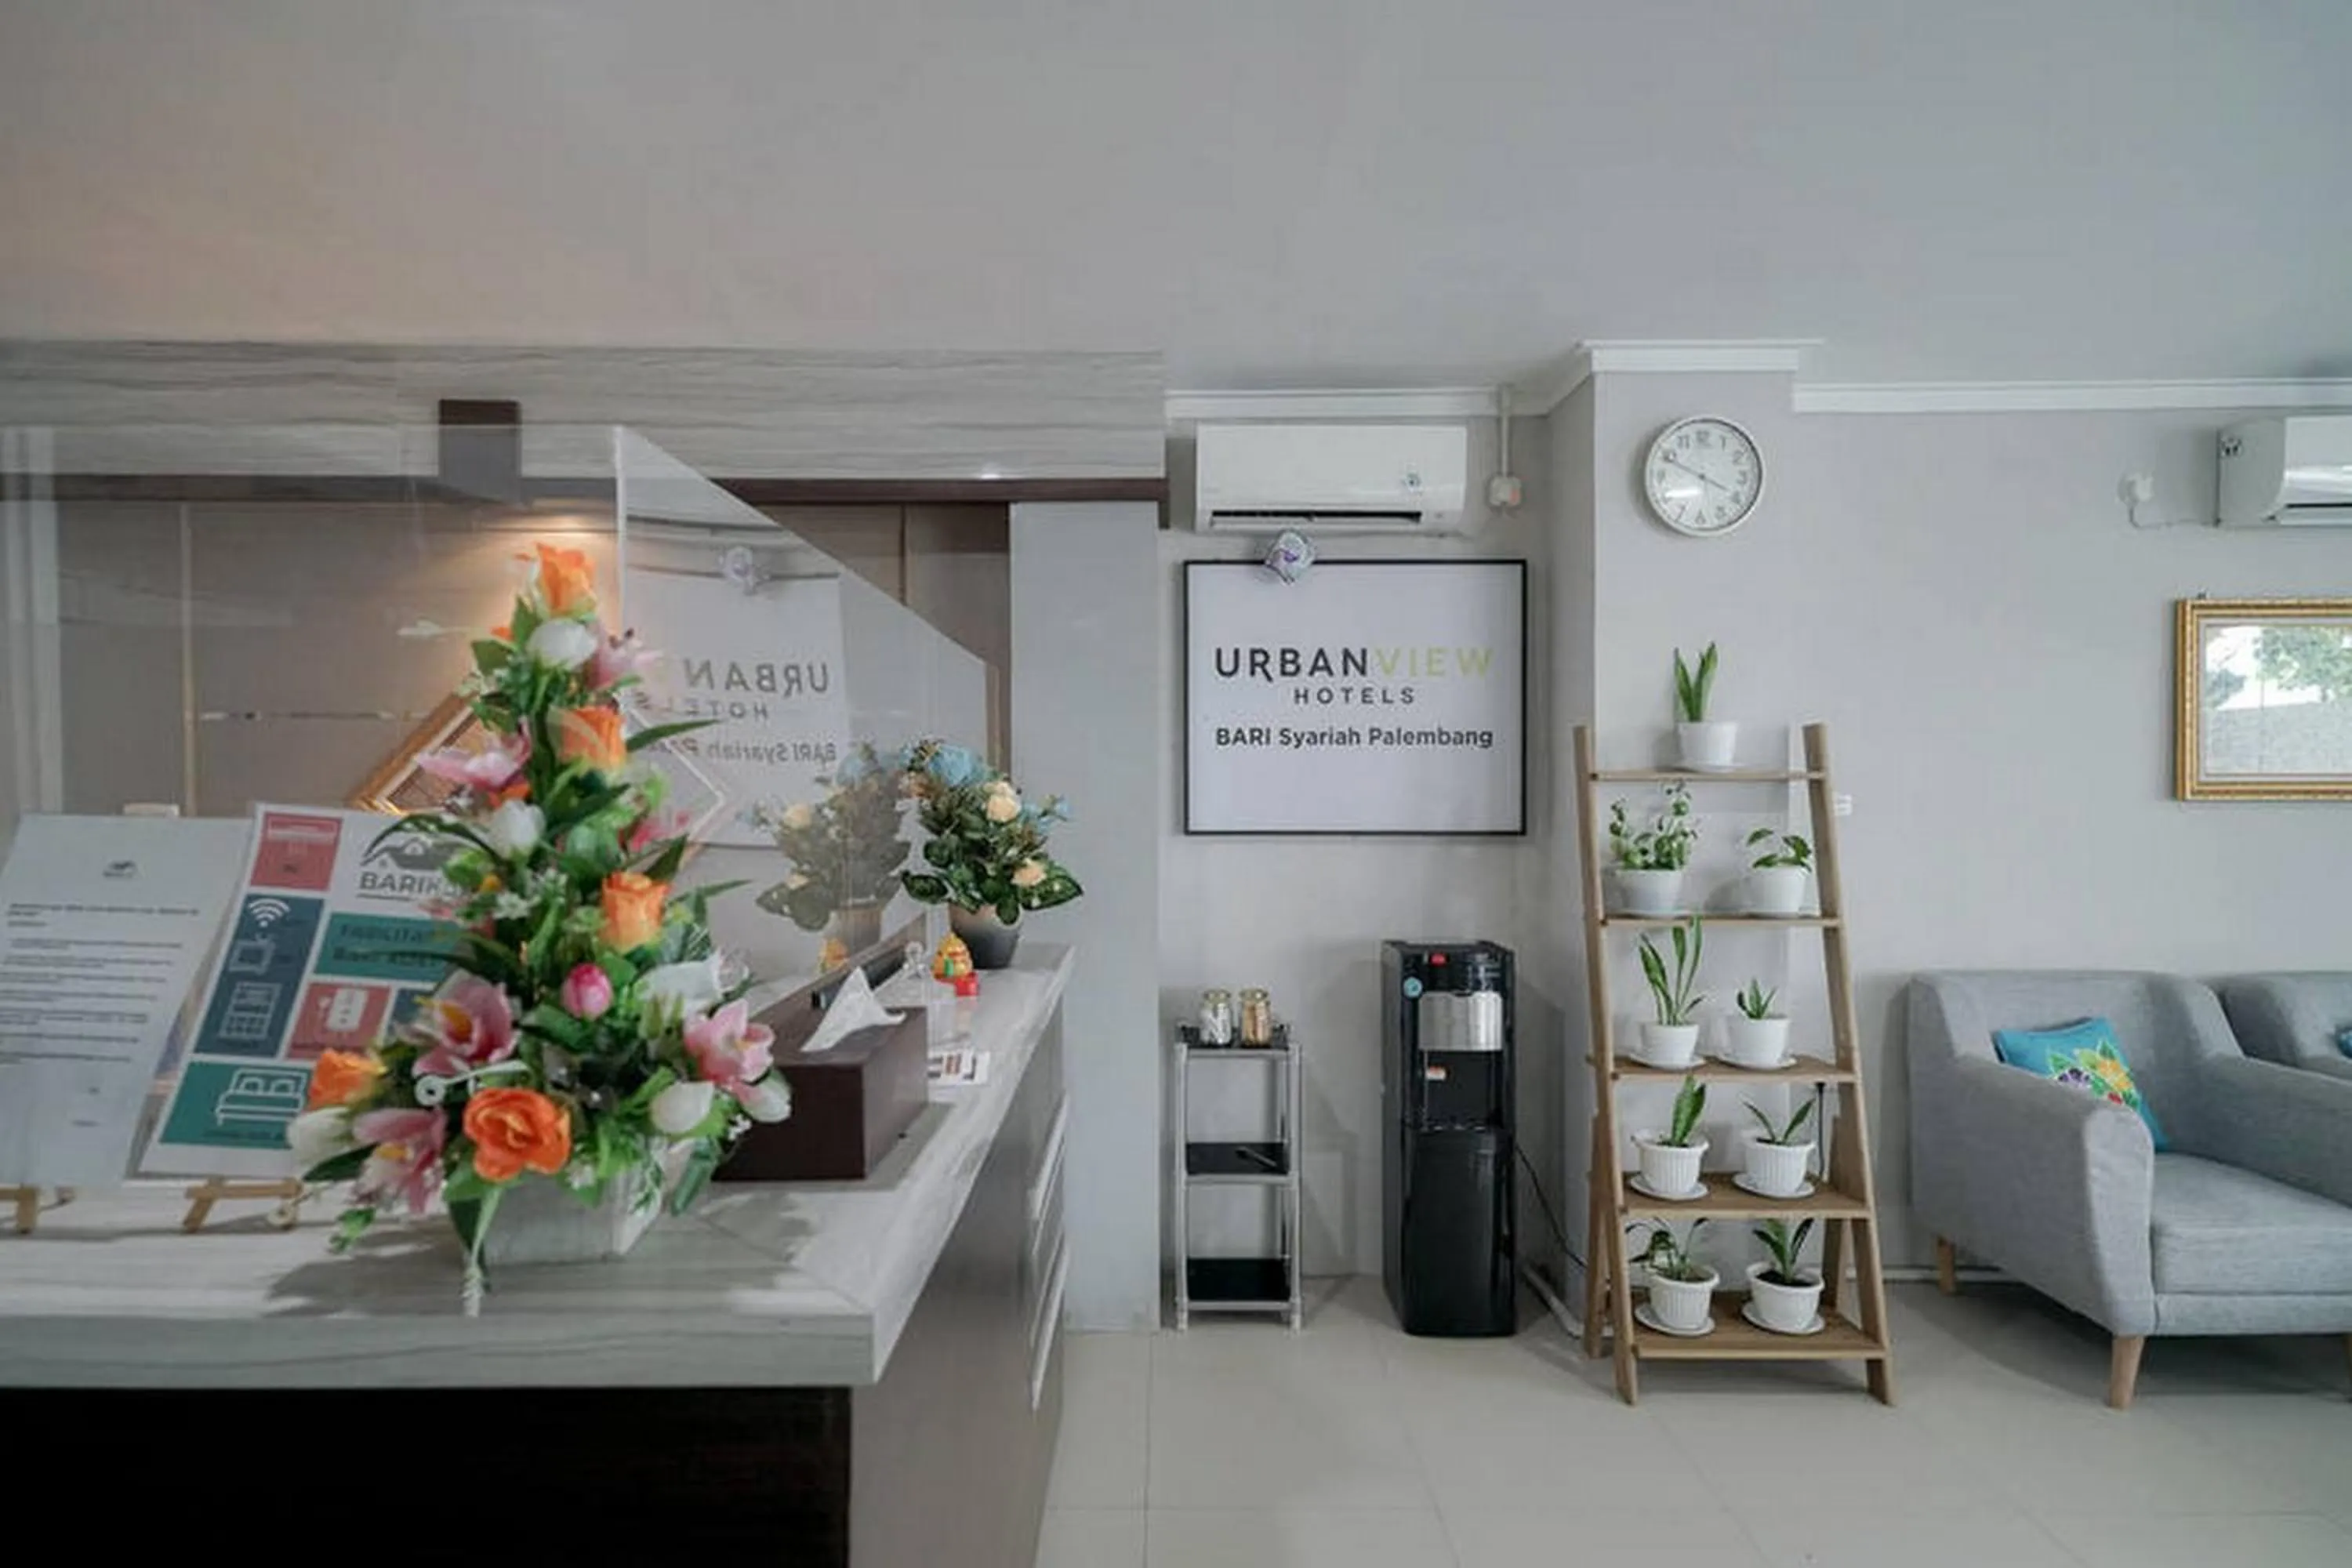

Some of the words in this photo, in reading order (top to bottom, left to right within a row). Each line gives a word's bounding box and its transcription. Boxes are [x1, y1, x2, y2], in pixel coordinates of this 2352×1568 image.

[1676, 434, 1690, 450] 11
[1695, 430, 1712, 449] 12
[1732, 450, 1745, 466] 2
[1737, 470, 1748, 485] 3
[1694, 509, 1707, 525] 6
[1216, 647, 1494, 683] URBANVIEW
[1294, 687, 1414, 705] HOTELS
[1216, 727, 1272, 746] BARI
[1279, 726, 1361, 749] Syariah
[1369, 725, 1494, 749] Palembang
